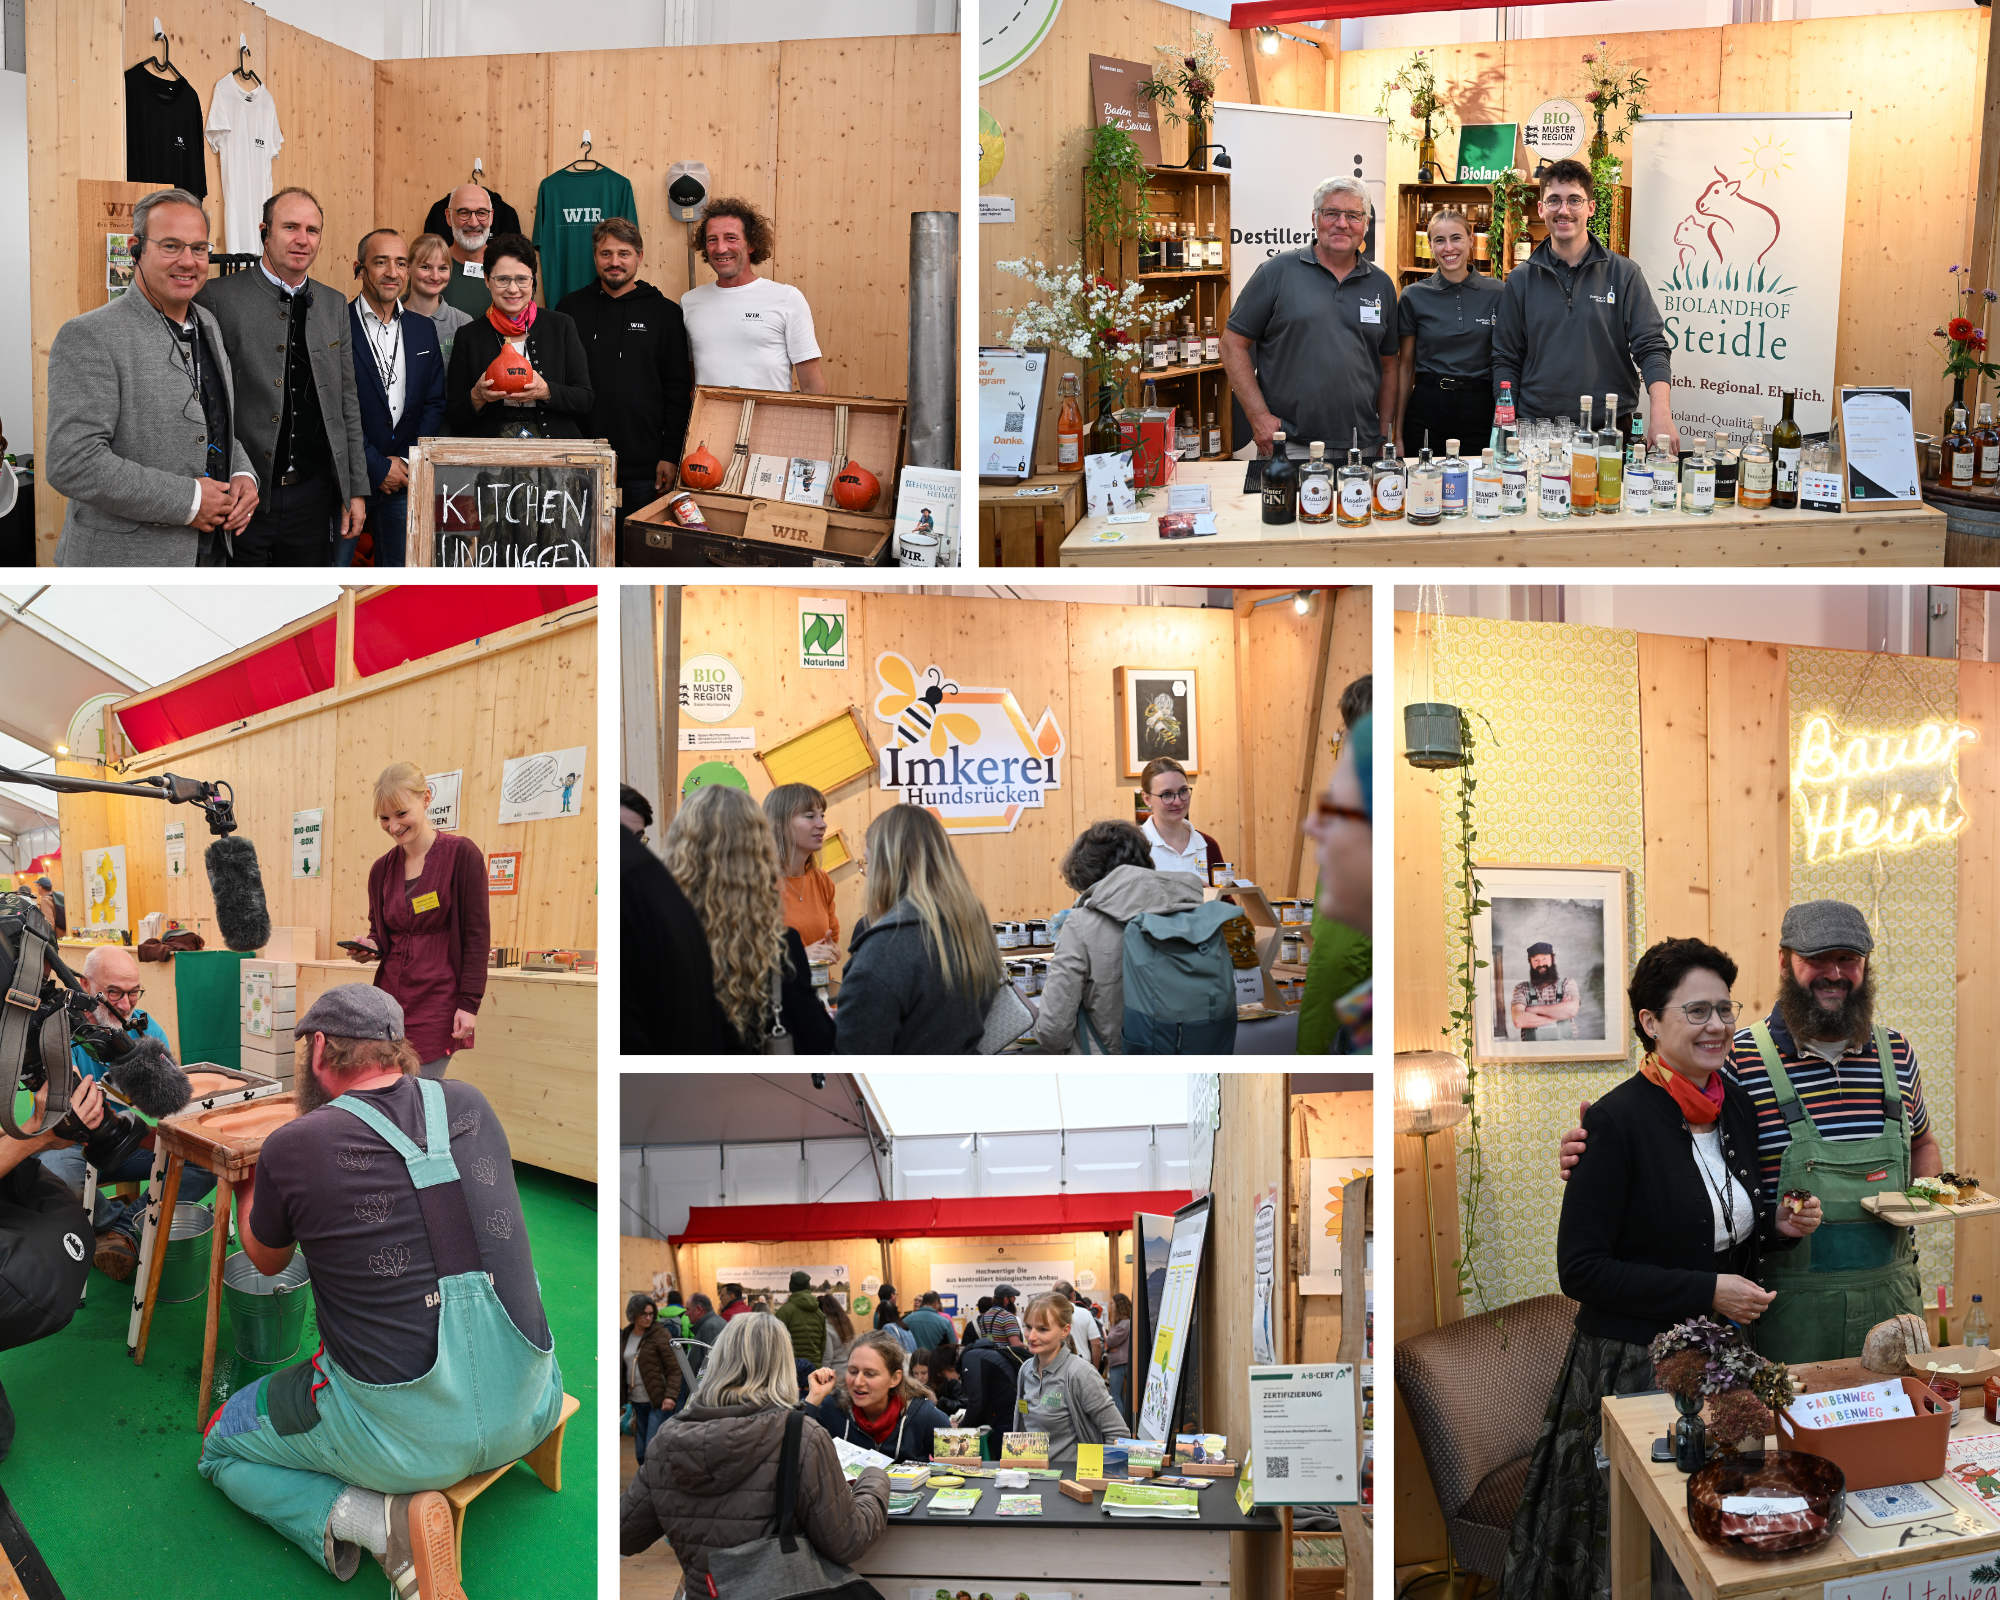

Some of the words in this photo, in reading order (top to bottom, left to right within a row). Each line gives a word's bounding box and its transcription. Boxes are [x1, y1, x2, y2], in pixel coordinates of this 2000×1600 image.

[1104, 102, 1132, 117] Baden
[1106, 116, 1124, 129] Bst
[1124, 119, 1152, 132] Spirits
[1543, 112, 1570, 125] BIO
[1542, 126, 1576, 134] MUSTER
[103, 202, 134, 217] WI
[563, 207, 605, 223] WIR.
[1230, 228, 1316, 244] Destilleri
[1664, 295, 1790, 319] BIOLANDHOF
[1664, 316, 1787, 360] Steidle
[507, 367, 528, 376] WIR.
[1700, 378, 1764, 396] Regional.
[1768, 385, 1825, 402] Ehlich.
[994, 436, 1024, 444] Danke.
[688, 464, 711, 476] WIR.
[838, 475, 862, 486] WIR.
[905, 480, 955, 493] SEEHNSUCHT
[927, 490, 957, 500] HEIMAT
[1263, 494, 1282, 505] GIN
[442, 483, 588, 529] KITCHEN
[772, 524, 813, 544] WIR.
[803, 658, 844, 667] Naturland
[693, 668, 726, 682] BIO
[693, 684, 733, 692] MUSTER
[693, 692, 730, 700] REGION
[1794, 717, 1976, 786] Bauer
[886, 744, 1057, 787] Imkerei
[907, 786, 1040, 806] Hundsrücken
[427, 805, 451, 815] NICHT
[1808, 786, 1964, 858] Heini
[294, 824, 320, 835] BIO-QUIZ
[299, 837, 314, 846] -BOX
[995, 1275, 1037, 1283] biologischem
[1263, 1391, 1322, 1399] ZERTIFIZIERUNG
[1806, 1392, 1875, 1410] FARBENWEG
[1814, 1407, 1884, 1427] FARBENWEG
